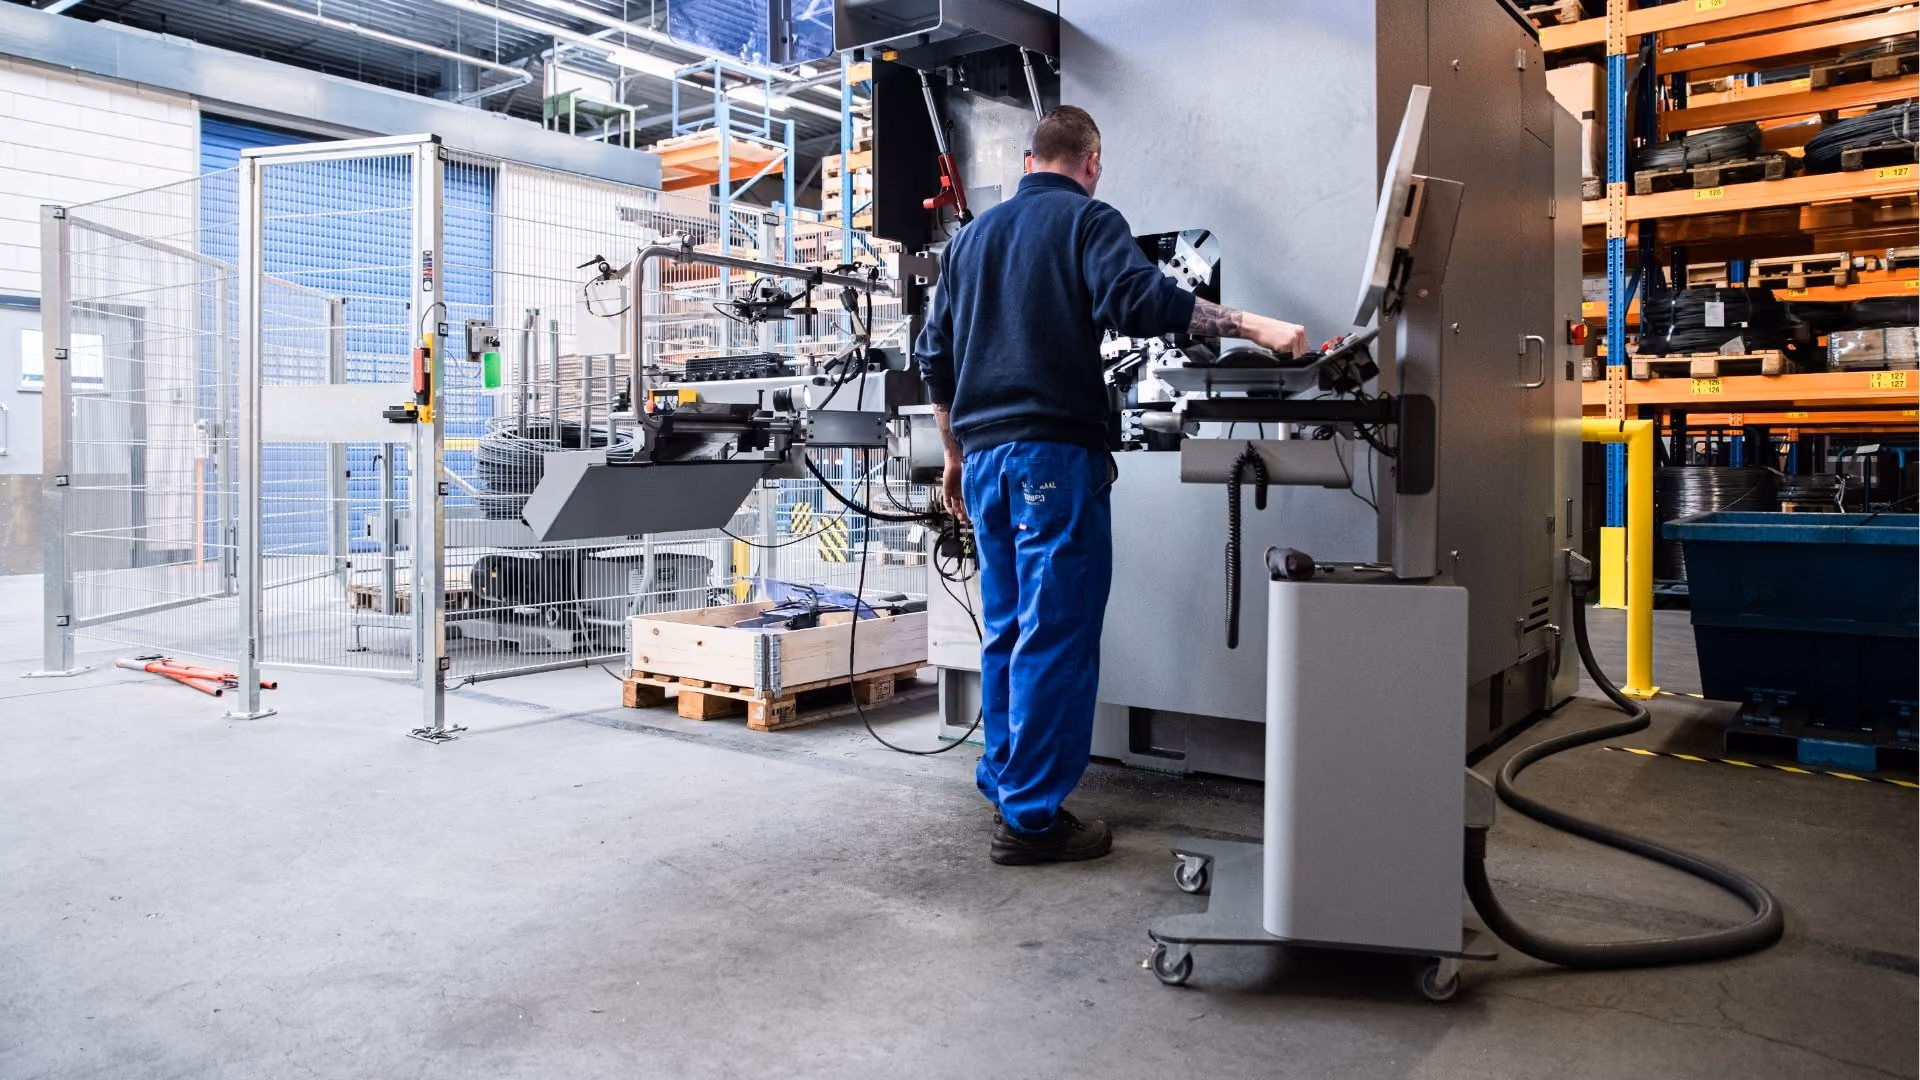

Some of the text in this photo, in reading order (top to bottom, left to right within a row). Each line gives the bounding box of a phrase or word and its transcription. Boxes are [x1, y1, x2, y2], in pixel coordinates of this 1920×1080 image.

[1893, 167, 1909, 176] 127
[1890, 372, 1904, 380] 127
[1891, 380, 1905, 388] 127
